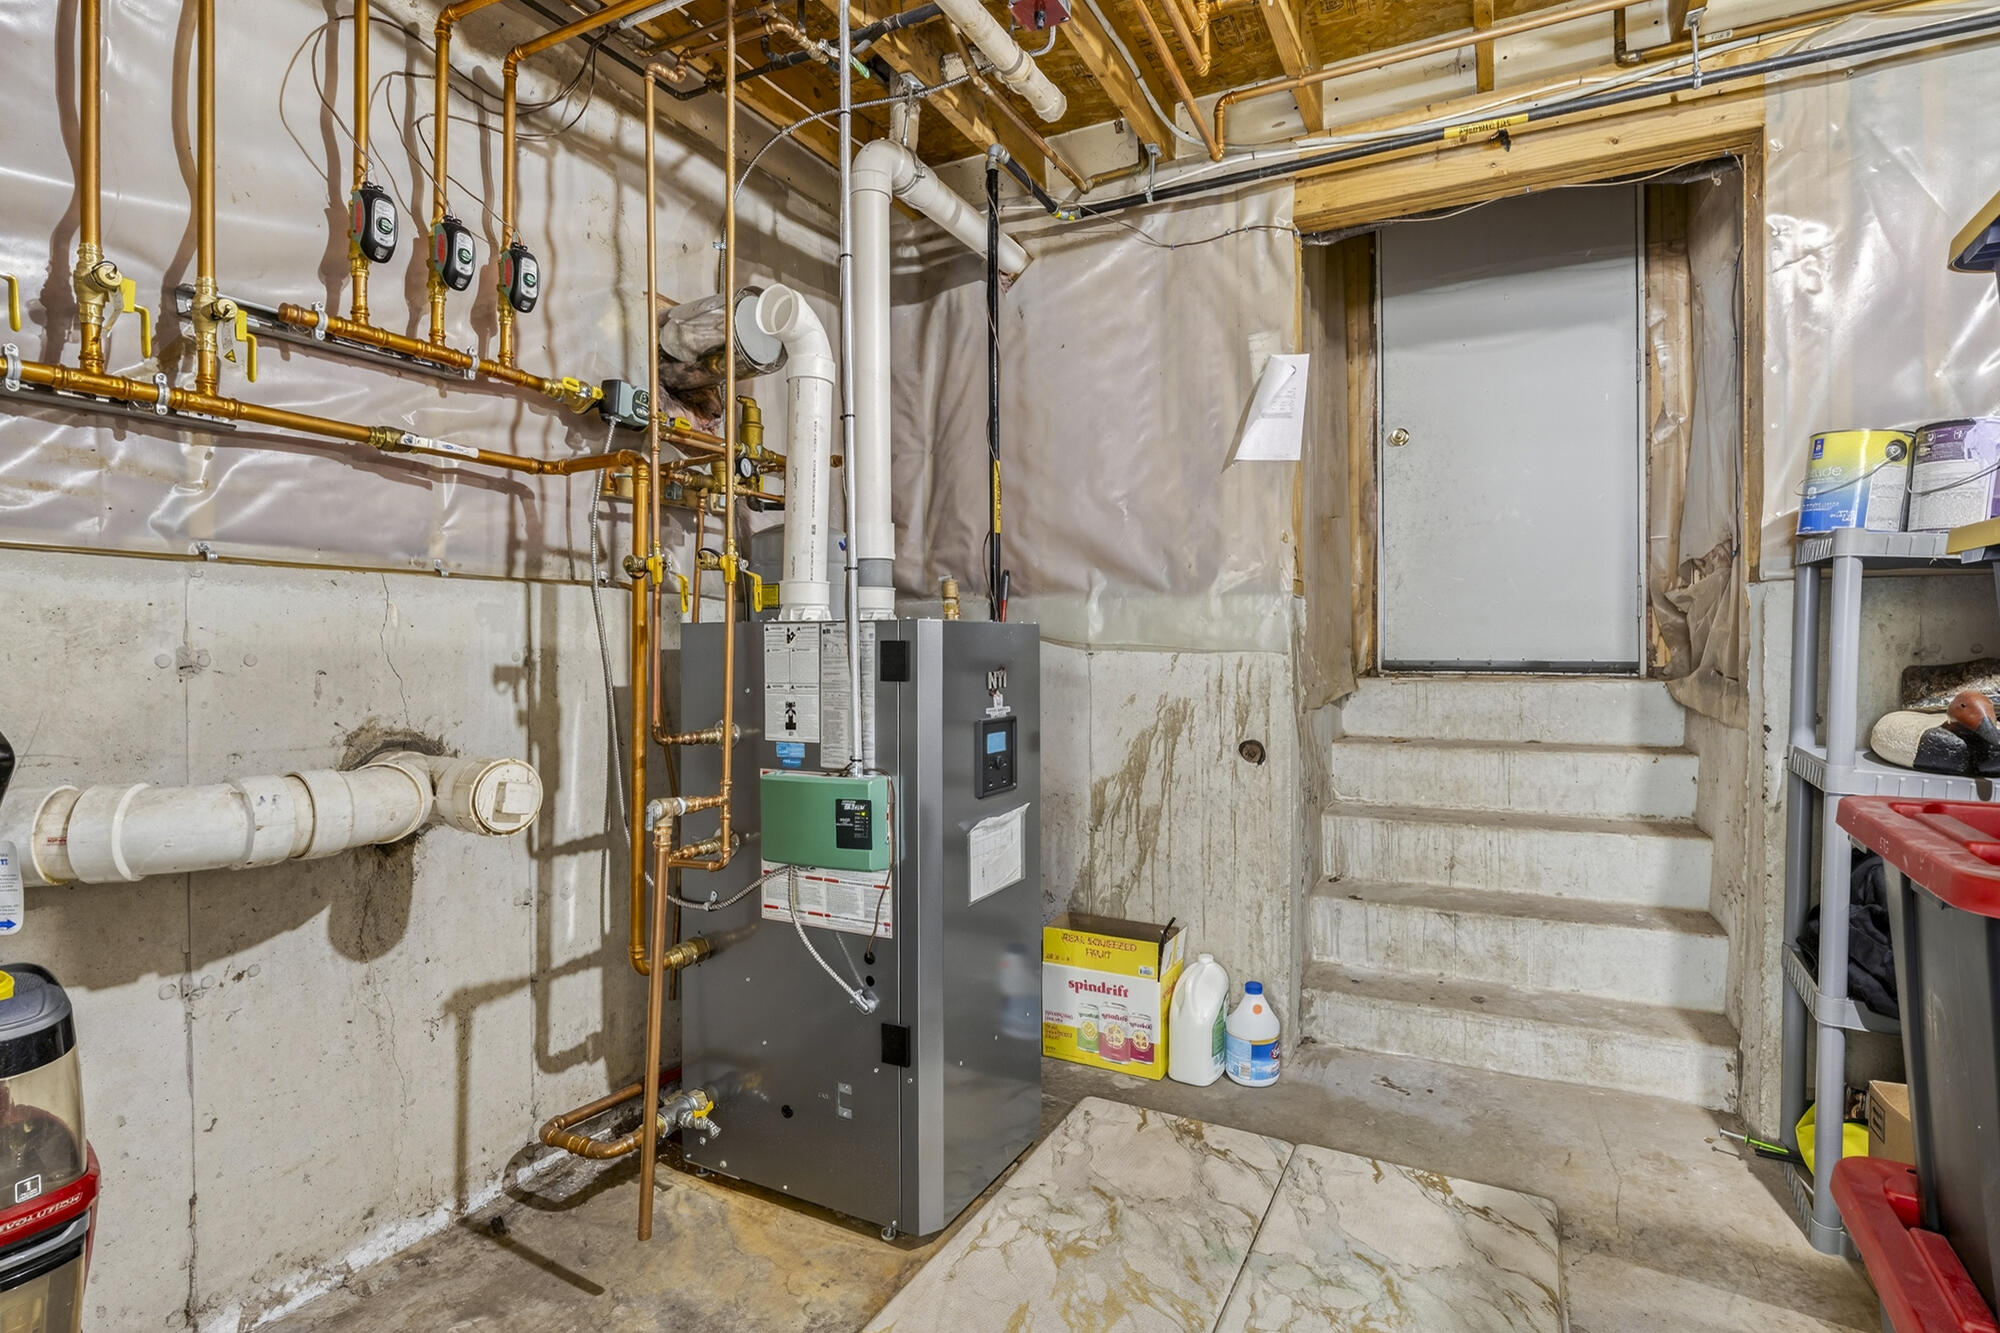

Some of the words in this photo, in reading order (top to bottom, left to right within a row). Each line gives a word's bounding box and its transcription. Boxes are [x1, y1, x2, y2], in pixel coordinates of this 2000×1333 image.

[1062, 933, 1085, 945] REAL
[1087, 936, 1137, 952] SQUEEZED
[1085, 948, 1112, 959] FRUIT
[1068, 979, 1129, 998] spindrift
